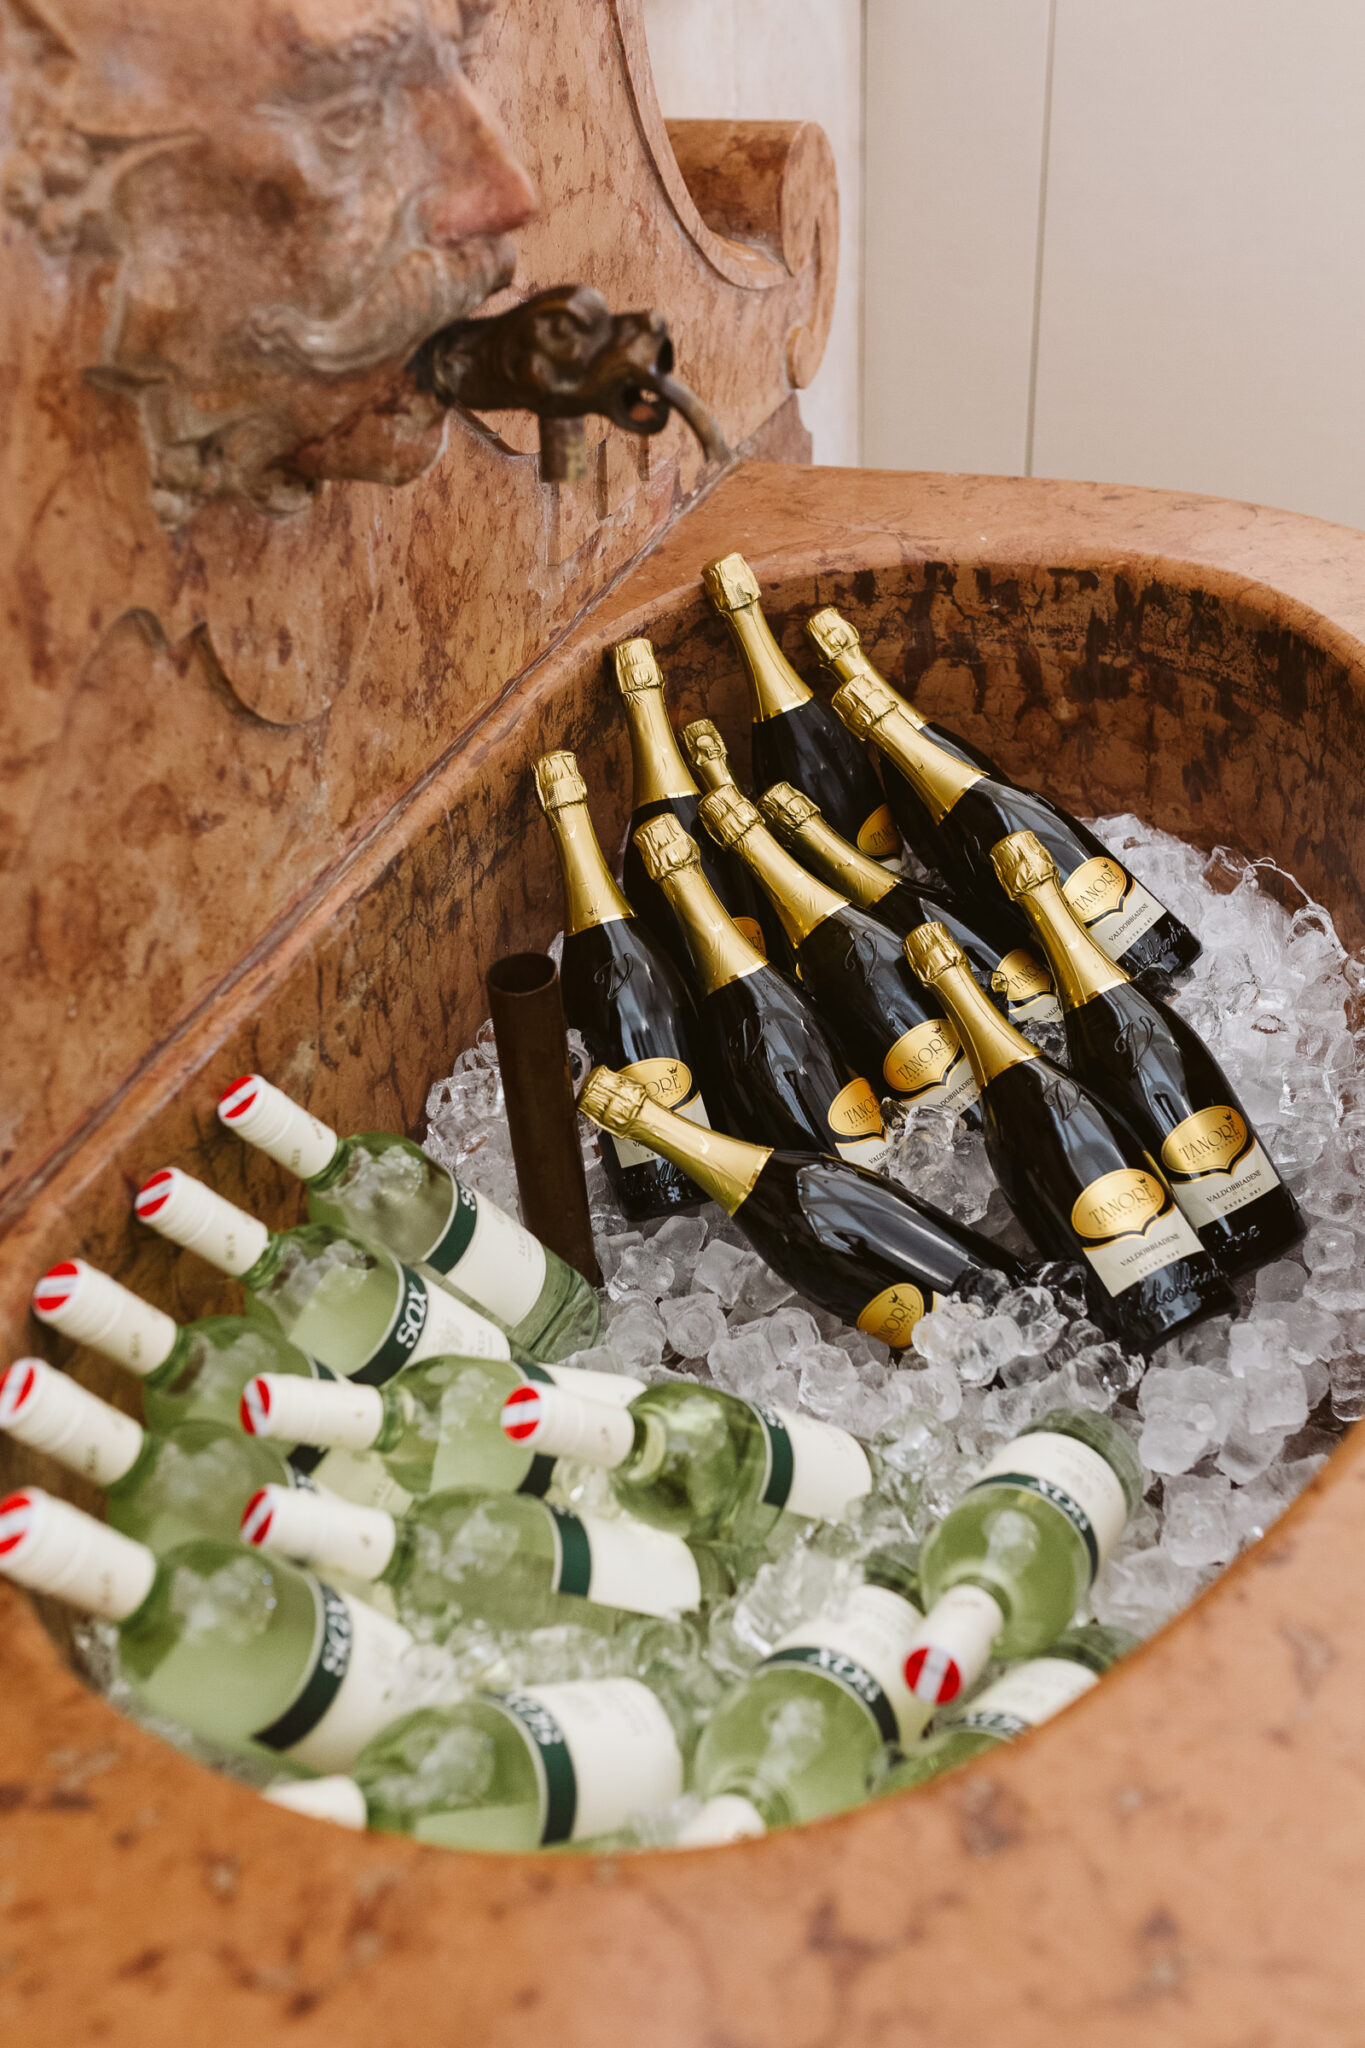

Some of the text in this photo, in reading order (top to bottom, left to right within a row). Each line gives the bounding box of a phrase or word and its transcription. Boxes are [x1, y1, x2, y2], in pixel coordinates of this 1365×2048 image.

[1108, 902, 1149, 942] VALDOBBIADENE
[645, 1074, 682, 1097] ORE
[939, 1075, 975, 1109] DOBBIADEN
[1206, 1168, 1262, 1203] VALDOBBIADENE
[1120, 1232, 1181, 1267] VALDOBBIADENE
